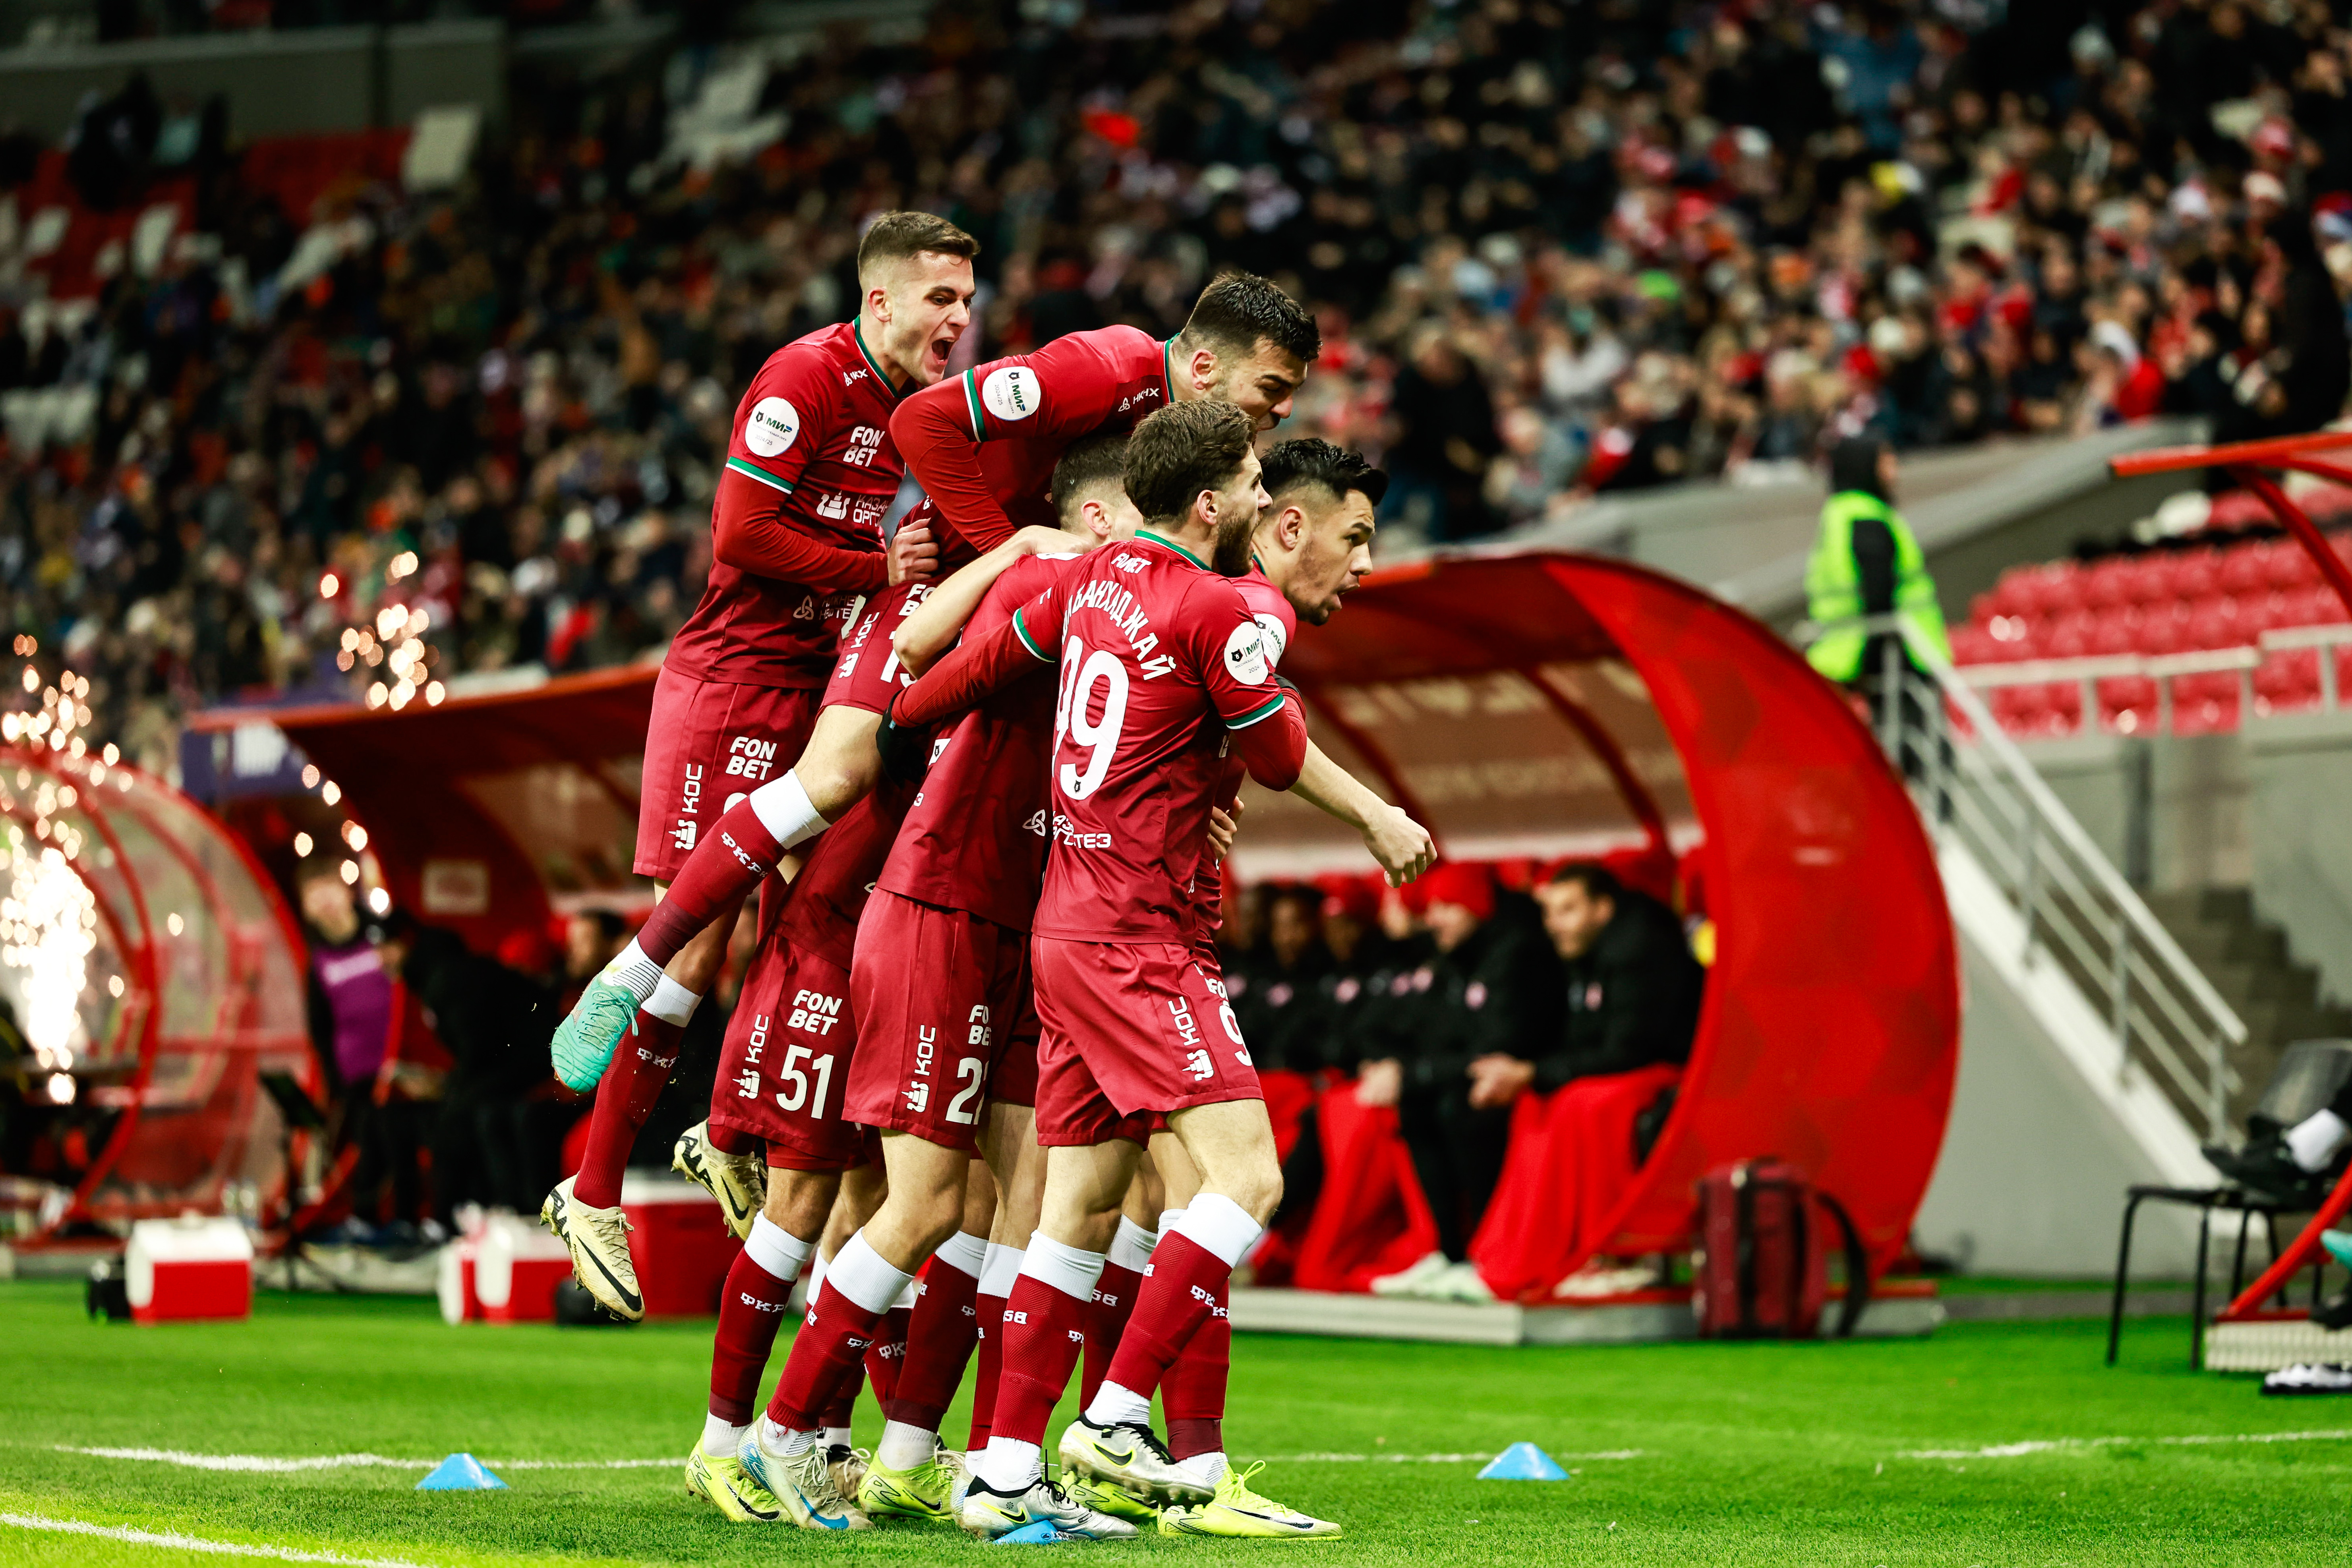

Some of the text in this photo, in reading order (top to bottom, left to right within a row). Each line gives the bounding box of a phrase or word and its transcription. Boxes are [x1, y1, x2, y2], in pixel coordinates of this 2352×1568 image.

[994, 384, 1003, 406] 2024/25
[1012, 384, 1026, 412] МИР
[766, 417, 792, 433] МИР
[850, 426, 886, 447] FON
[755, 434, 773, 446] 2024/25
[843, 445, 878, 467] BET
[729, 736, 777, 760] FON
[725, 755, 773, 780] BET
[792, 989, 843, 1016] FON
[787, 1008, 839, 1036] BET
[968, 1005, 989, 1024] FO
[776, 1044, 834, 1119] 51
